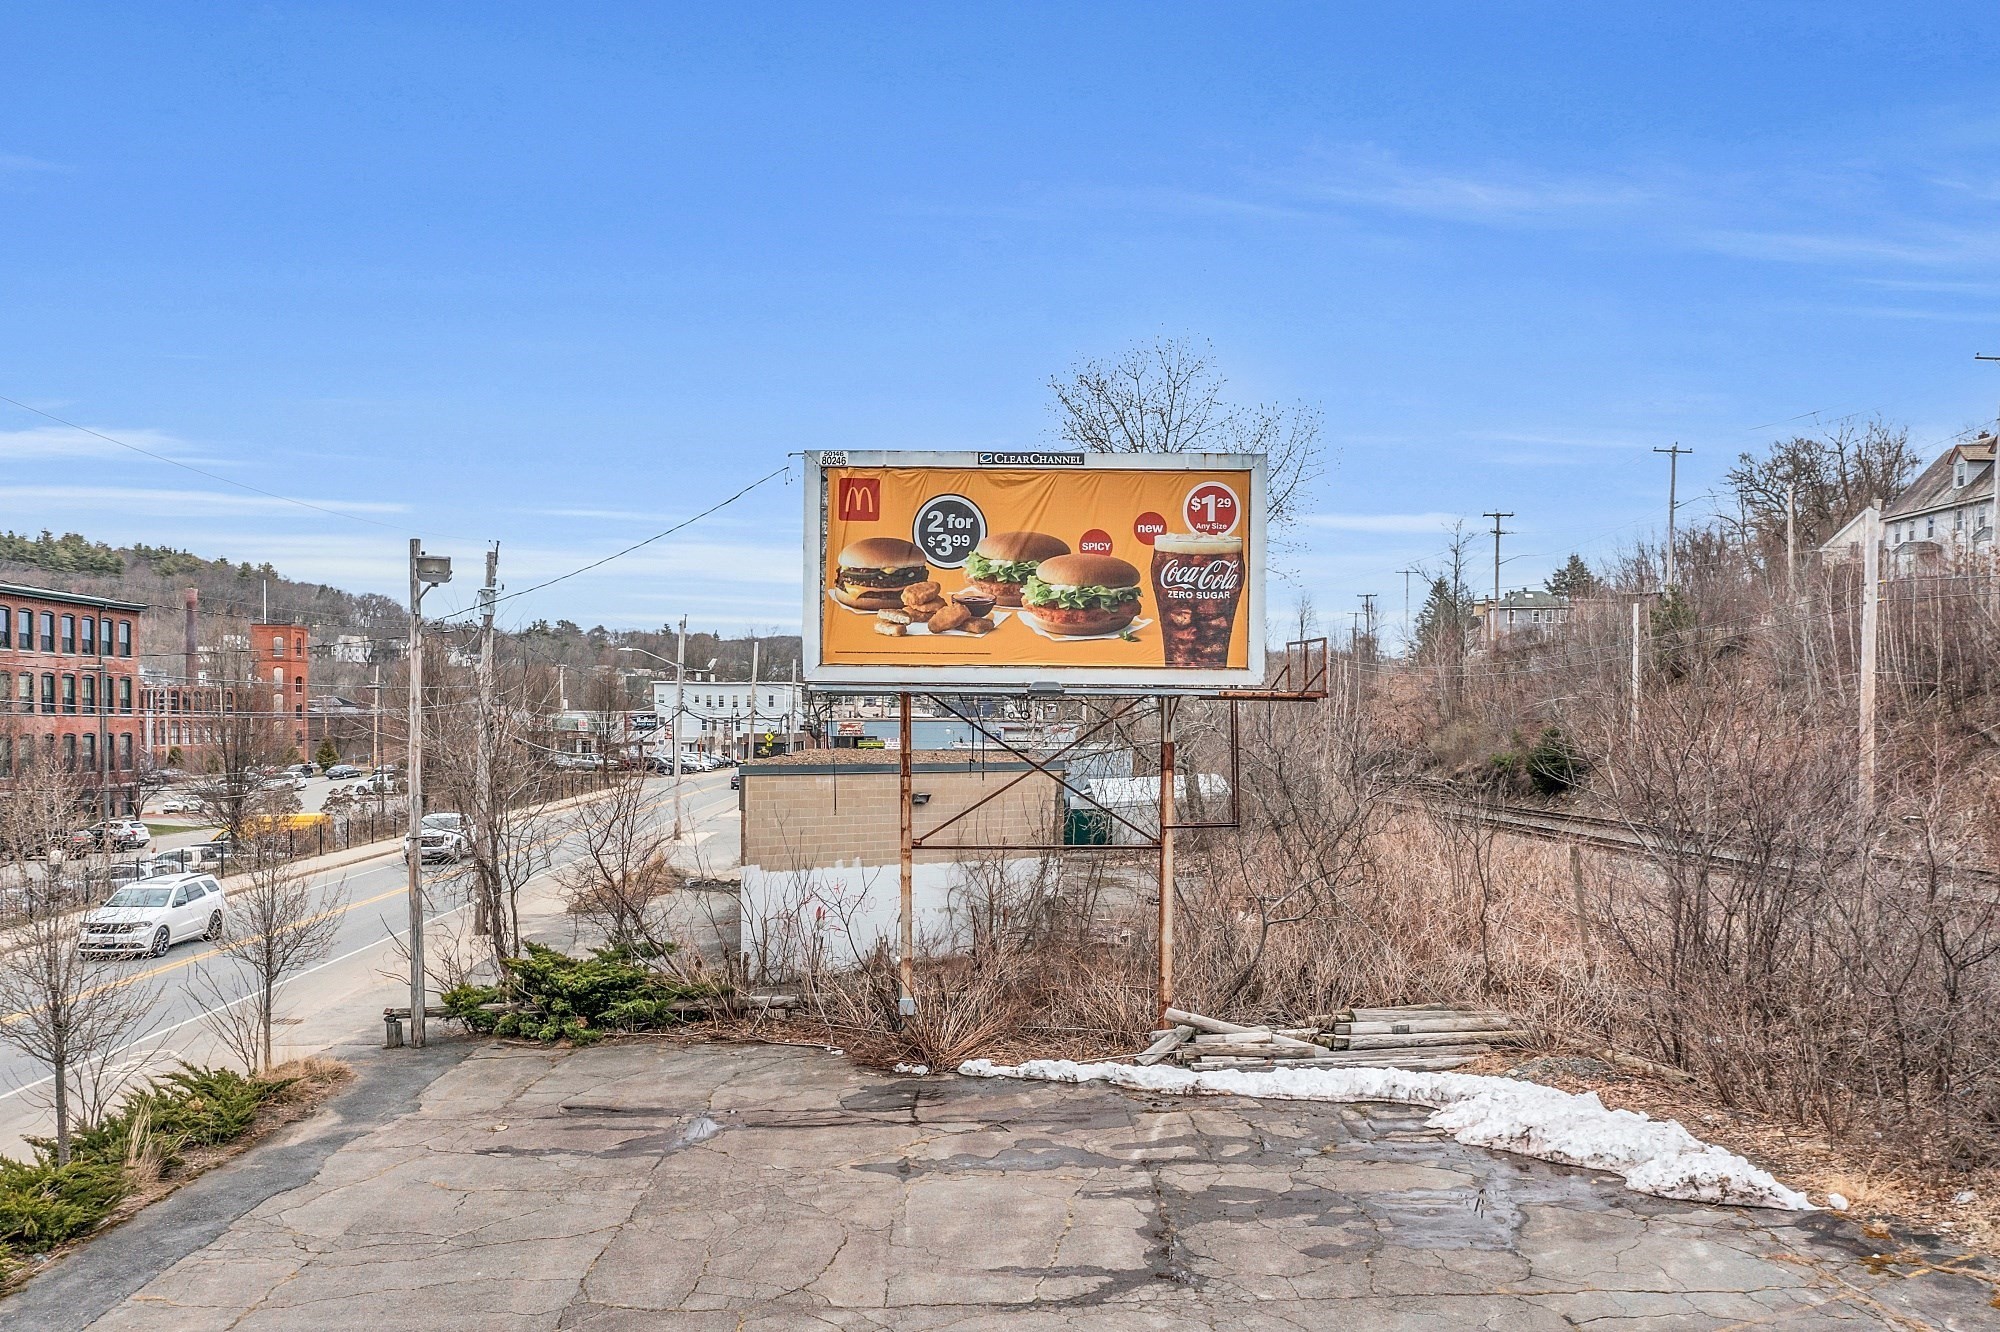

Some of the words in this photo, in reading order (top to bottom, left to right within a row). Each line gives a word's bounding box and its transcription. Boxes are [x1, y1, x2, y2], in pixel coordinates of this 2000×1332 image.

[821, 456, 847, 466] 80246
[927, 510, 944, 533] 2
[946, 513, 974, 529] for
[1196, 522, 1211, 531] Any
[1211, 522, 1228, 530] Size
[1137, 524, 1164, 533] new
[1081, 542, 1112, 551] SPICY
[1161, 559, 1239, 590] Coca-Cola
[1167, 590, 1193, 599] ZERO
[1196, 590, 1231, 600] SUGAR
